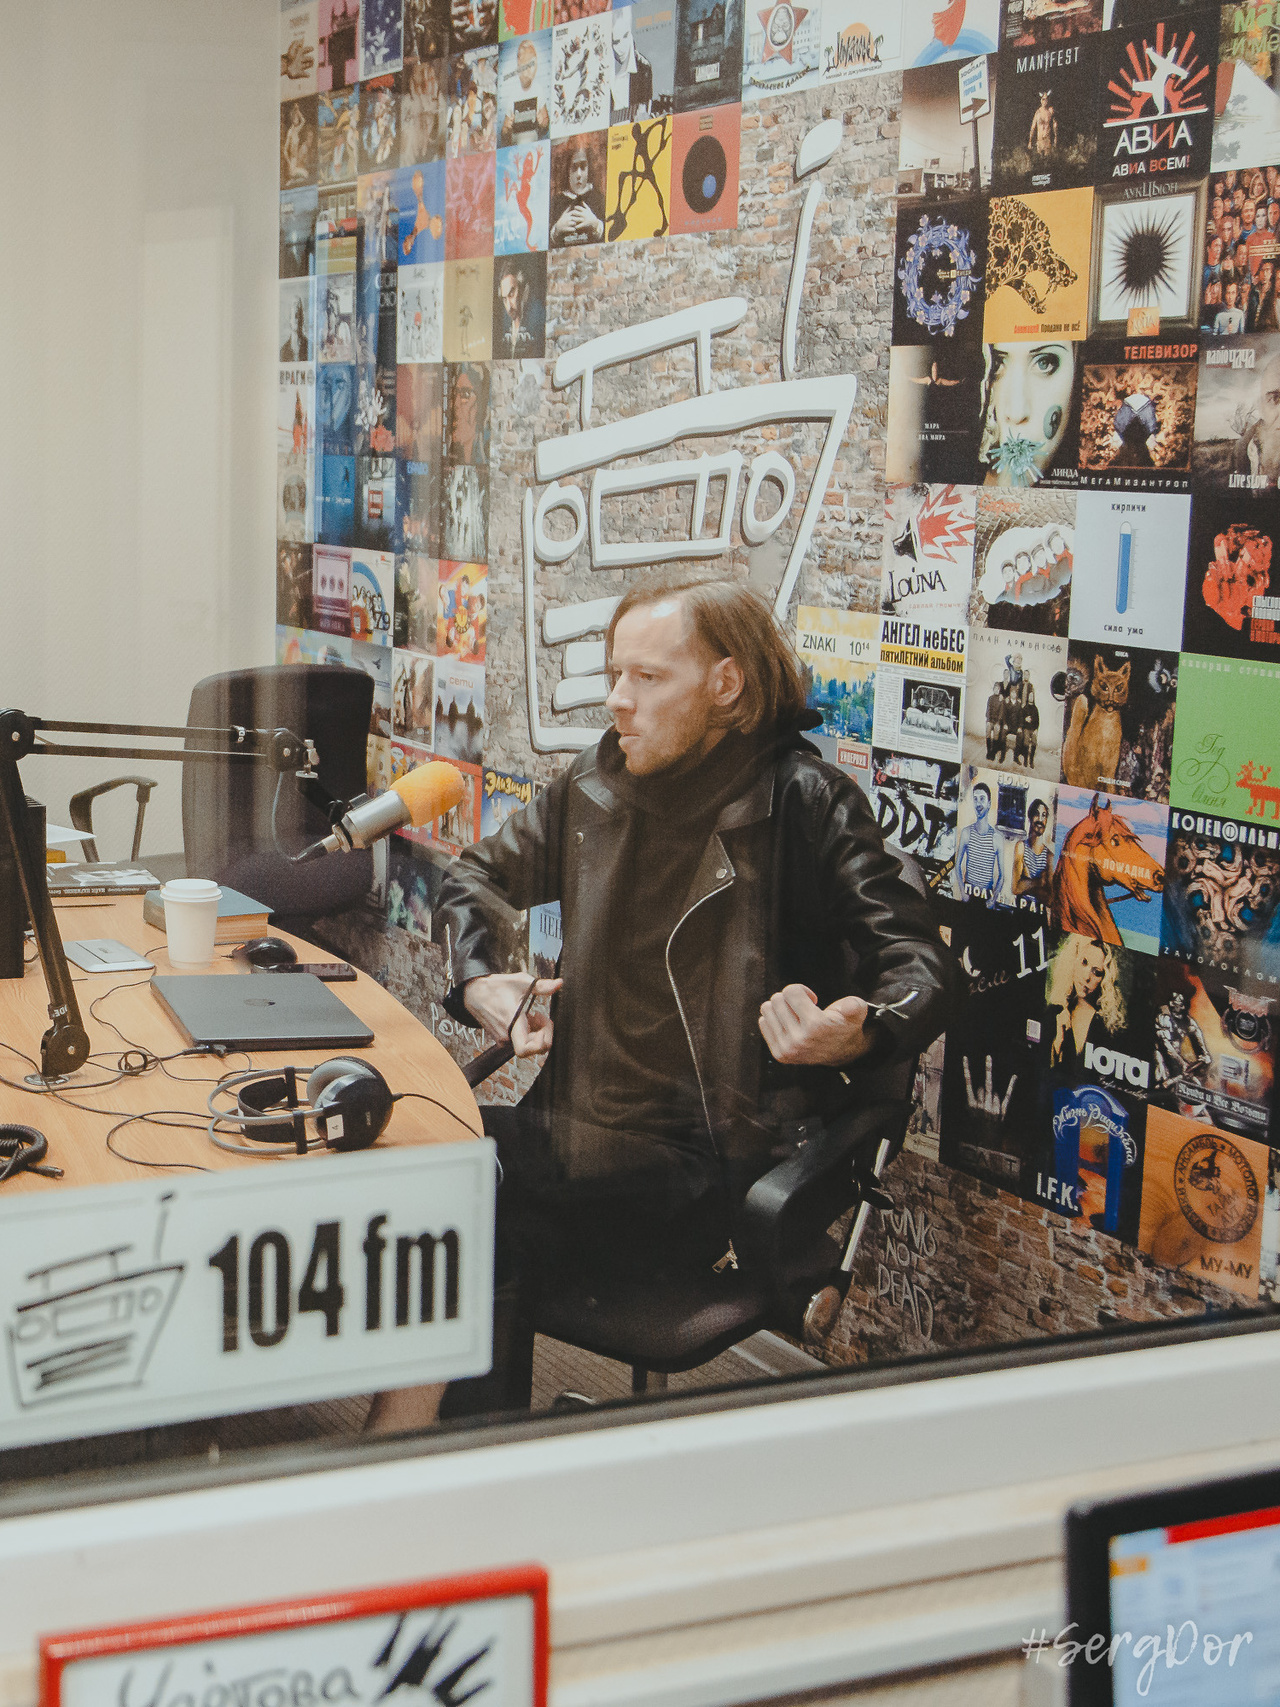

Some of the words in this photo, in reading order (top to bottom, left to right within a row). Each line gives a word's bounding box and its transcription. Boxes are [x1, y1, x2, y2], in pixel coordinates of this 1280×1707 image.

[1016, 47, 1079, 73] MANIFEST
[1113, 120, 1193, 157] АВИА
[1112, 160, 1146, 177] АВИА
[1149, 154, 1191, 172] ВСЕМ!
[1124, 344, 1199, 360] ТЕЛЕВИЗОР
[1051, 468, 1079, 479] ЛИНДА
[1111, 503, 1146, 514] кирпичи
[802, 633, 836, 653] ZNAKI
[881, 619, 921, 648] АНГЕЛ
[1104, 624, 1123, 634] сила
[1127, 626, 1144, 636] ума
[930, 656, 964, 673] альбом
[1013, 926, 1049, 978] 11
[1036, 1172, 1079, 1212] I.F.K.
[886, 1235, 925, 1267] NOT
[1199, 1254, 1254, 1280] МУ-МУ
[209, 1220, 345, 1353] 104
[363, 1213, 461, 1332] fm
[877, 1263, 934, 1341] DEAD
